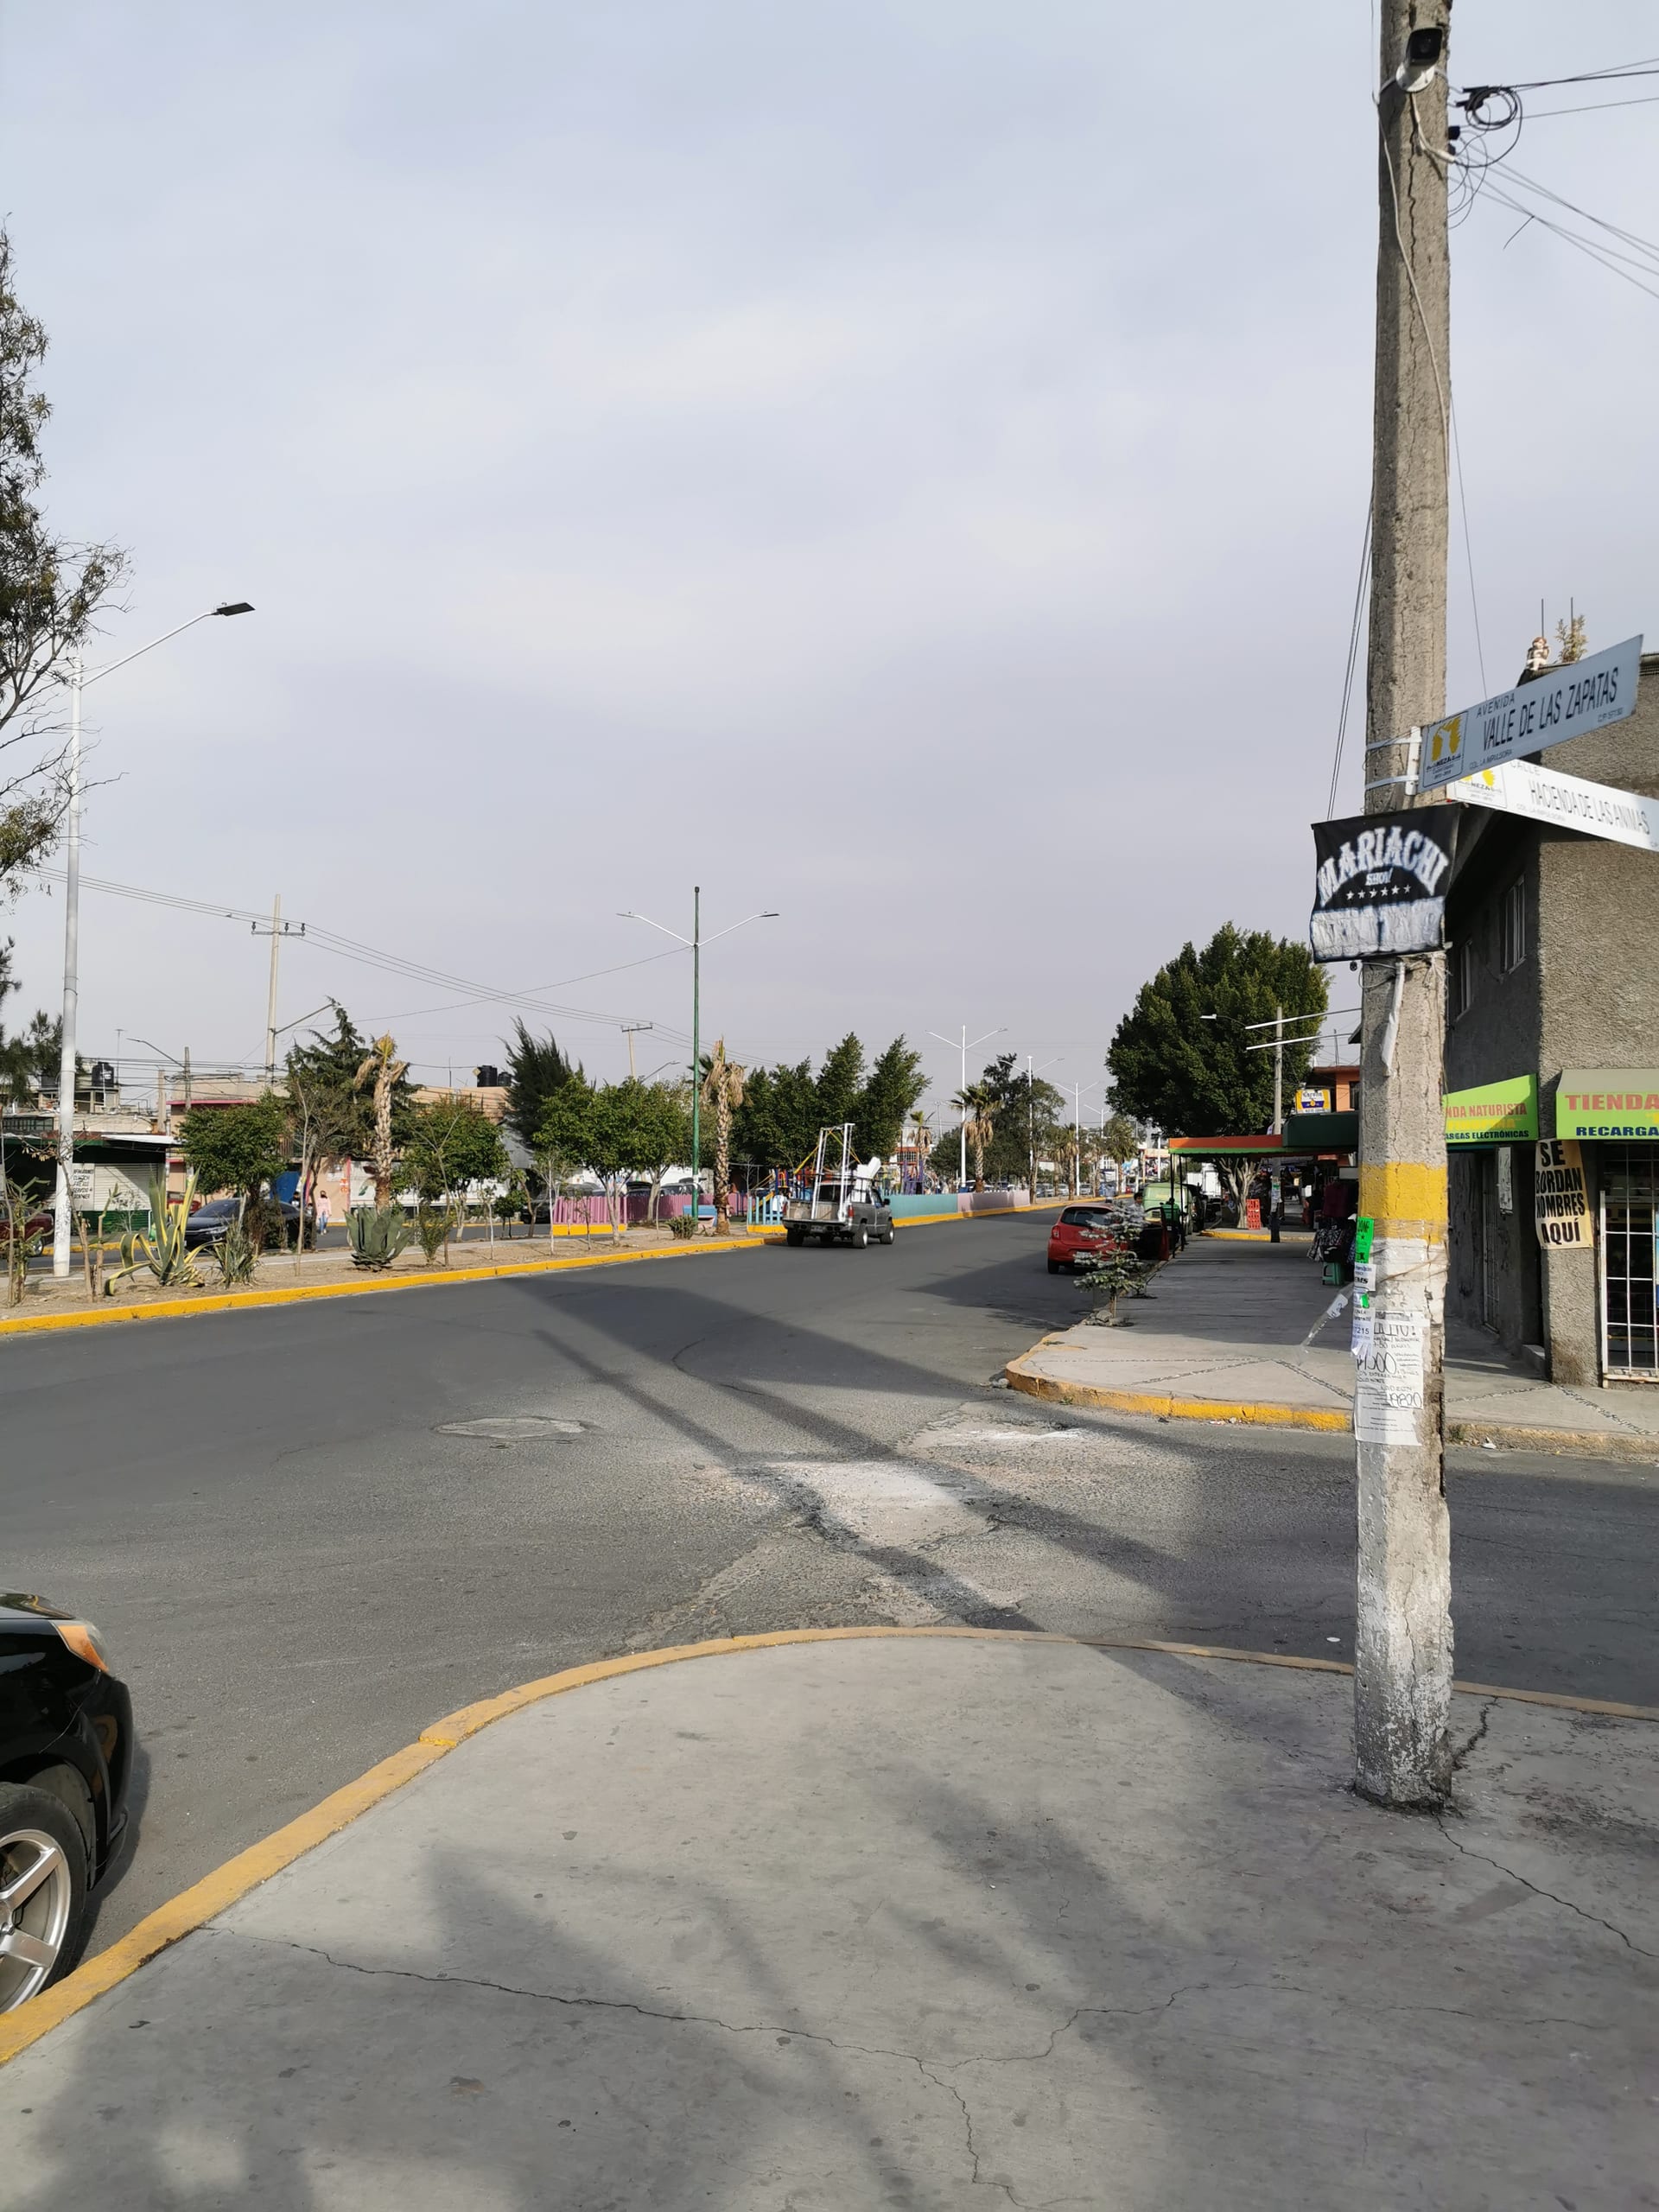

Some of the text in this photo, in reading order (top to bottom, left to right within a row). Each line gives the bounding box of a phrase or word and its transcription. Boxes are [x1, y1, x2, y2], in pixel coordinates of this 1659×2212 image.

[1476, 693, 1516, 717] AVENIDA
[1483, 666, 1619, 751] VALLE DE LAS ZAPATAS
[1527, 779, 1581, 817] HACIENDA
[1577, 793, 1594, 819] DE
[1592, 796, 1613, 825] LAS
[1317, 825, 1450, 907] MARIACHI
[1469, 1103, 1528, 1116] NATURISTA
[1565, 1093, 1659, 1110] TIENDA
[1471, 1129, 1529, 1140] ELECTRÓNICAS
[1540, 1141, 1566, 1167] SE
[1535, 1167, 1583, 1194] BORDAN
[1535, 1192, 1586, 1218] NOMBRES
[1541, 1217, 1581, 1245] AQUÍ
